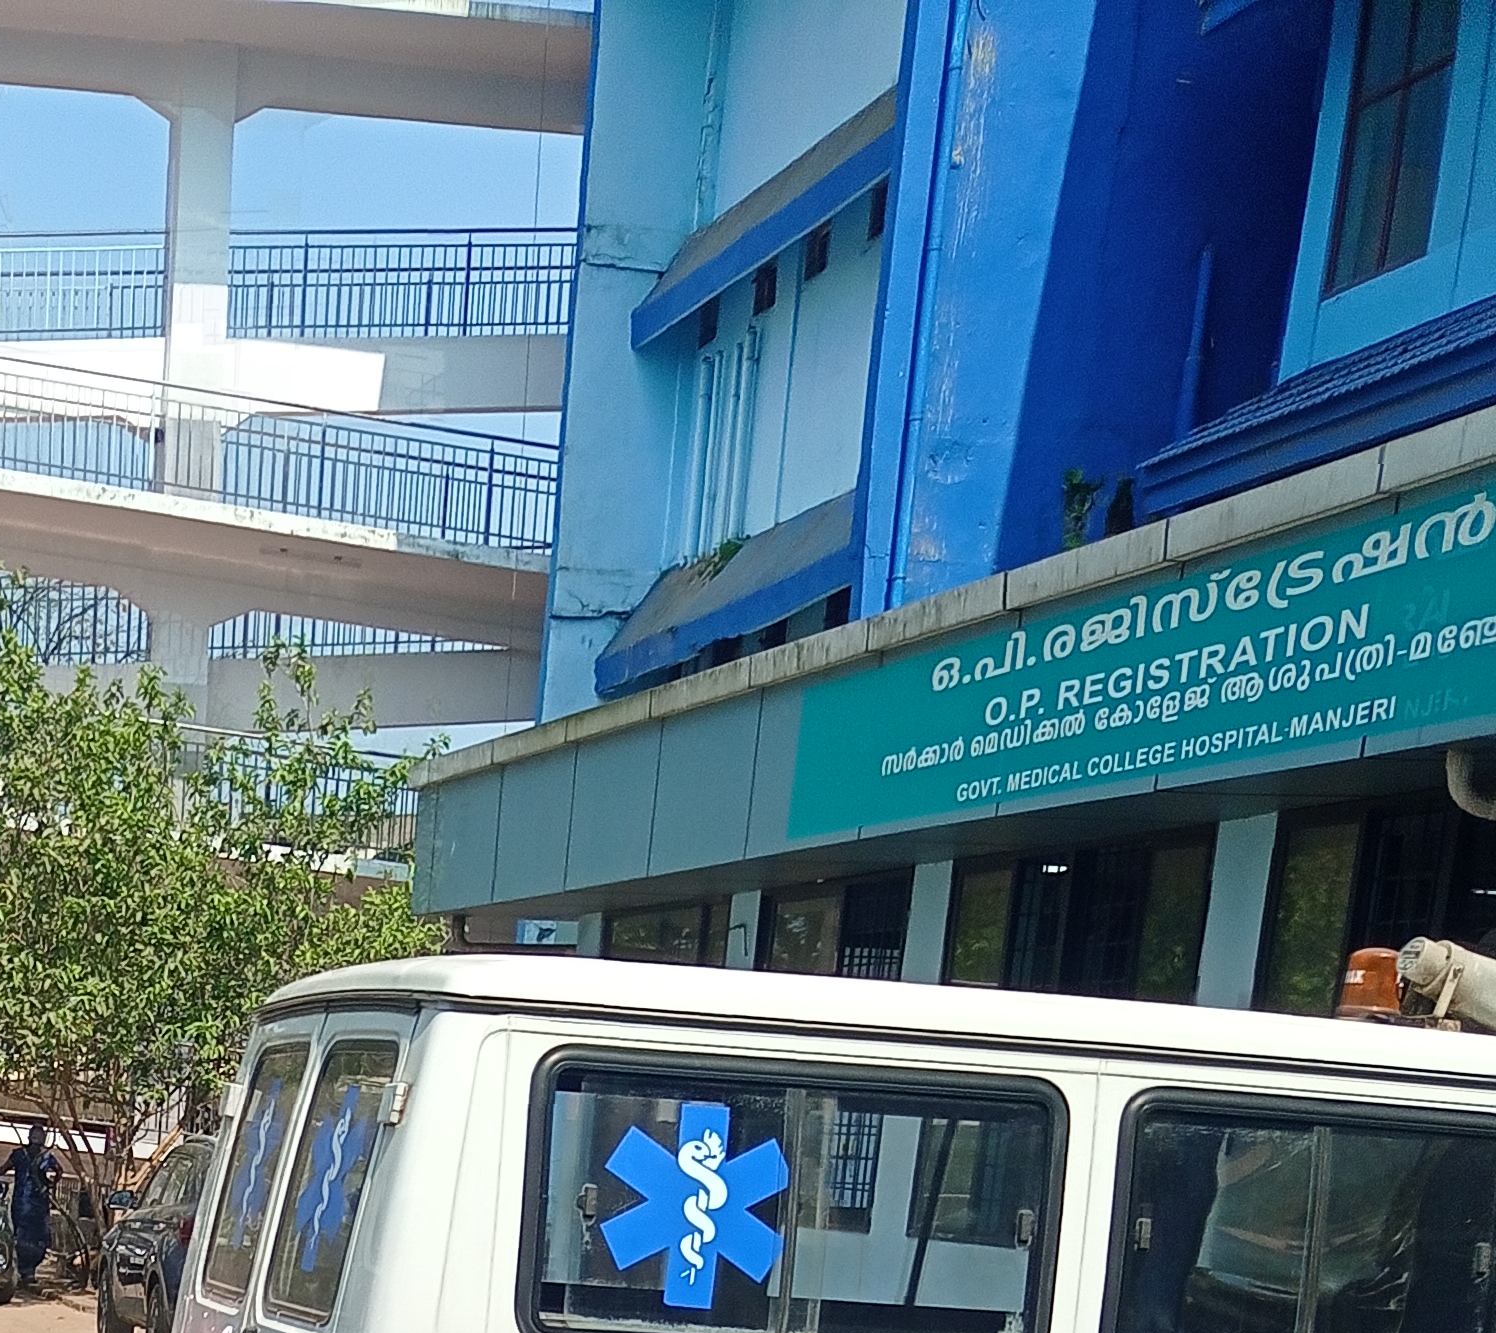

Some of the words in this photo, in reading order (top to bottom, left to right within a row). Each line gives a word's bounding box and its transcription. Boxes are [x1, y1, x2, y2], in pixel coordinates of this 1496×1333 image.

[984, 688, 1045, 726] O.P.
[1056, 603, 1370, 711] REGISTRATION
[956, 776, 1003, 802] GOVT.
[1006, 760, 1083, 793] MEDICAL
[1086, 741, 1177, 778] COLLEGE
